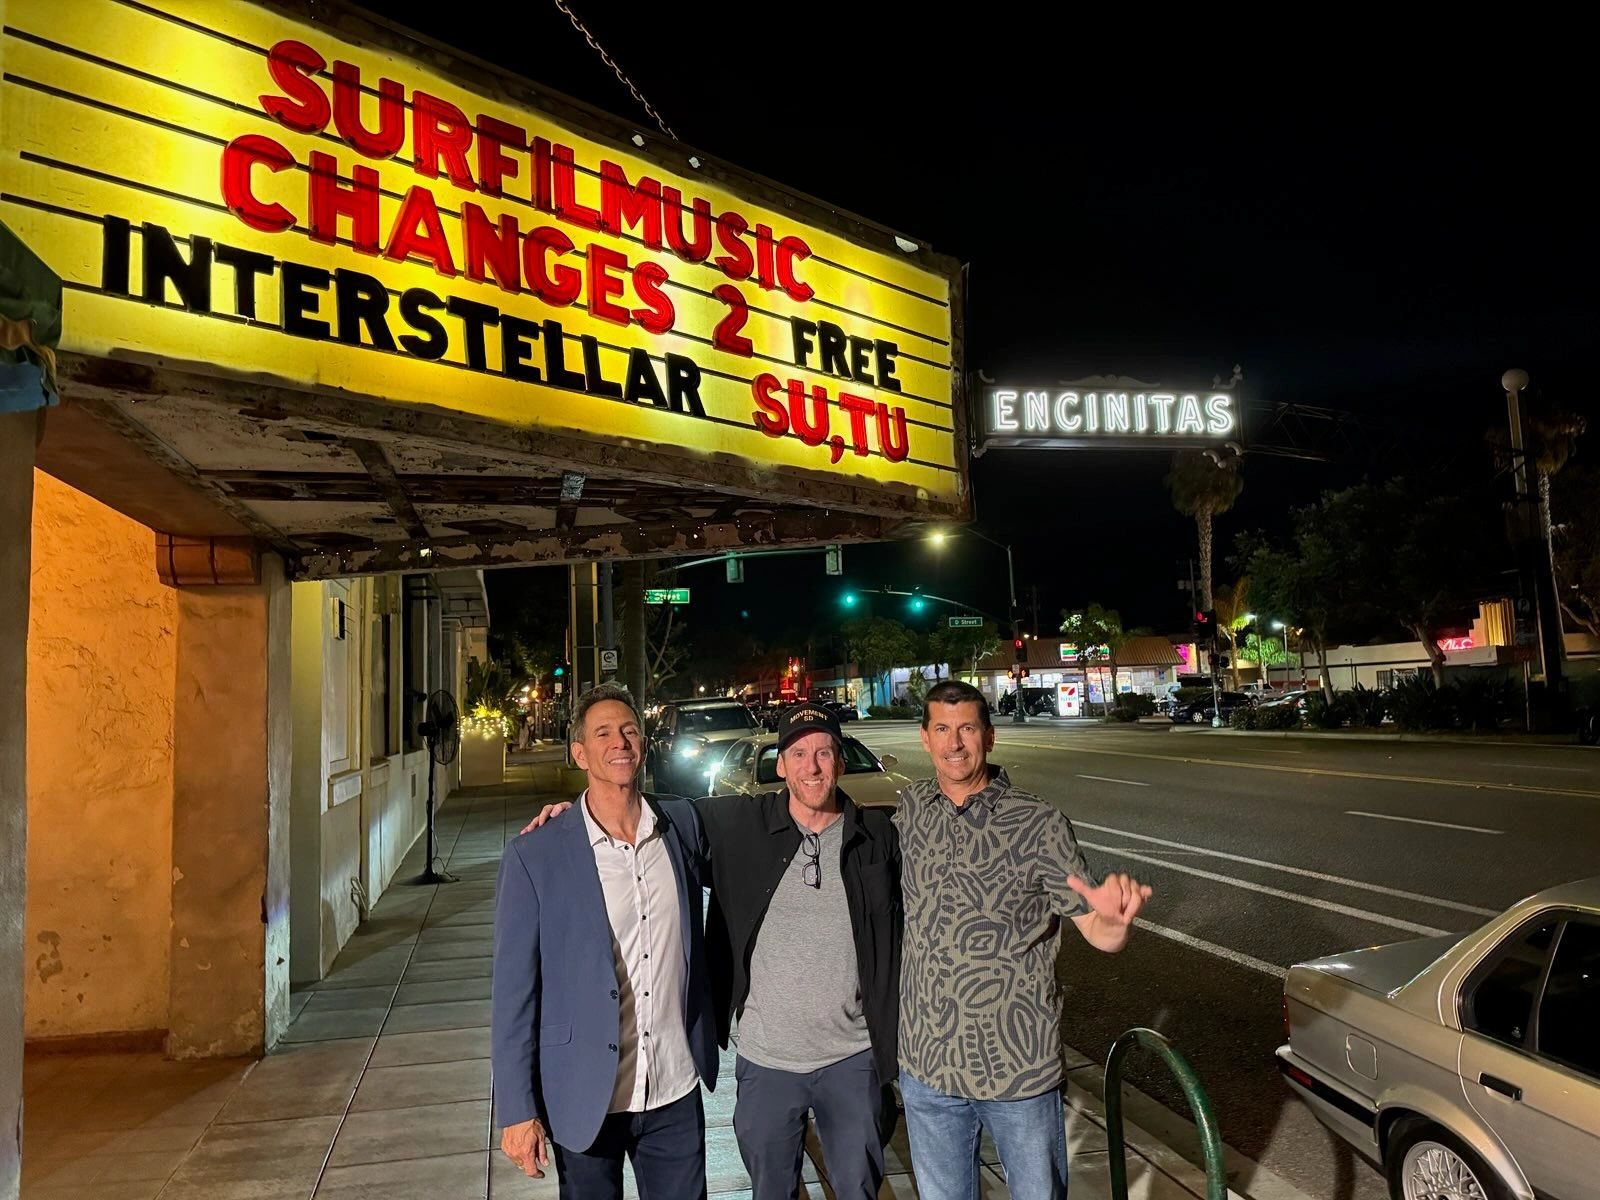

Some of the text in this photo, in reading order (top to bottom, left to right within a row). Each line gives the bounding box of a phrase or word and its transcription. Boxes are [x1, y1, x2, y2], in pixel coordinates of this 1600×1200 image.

[220, 134, 902, 392] CHANGES 2 FREE
[259, 40, 813, 302] SURFILMUSIC
[102, 214, 707, 418] INTERSTELLAR
[992, 391, 1234, 433] ENCINITAS
[790, 709, 828, 724] MOVEMENT
